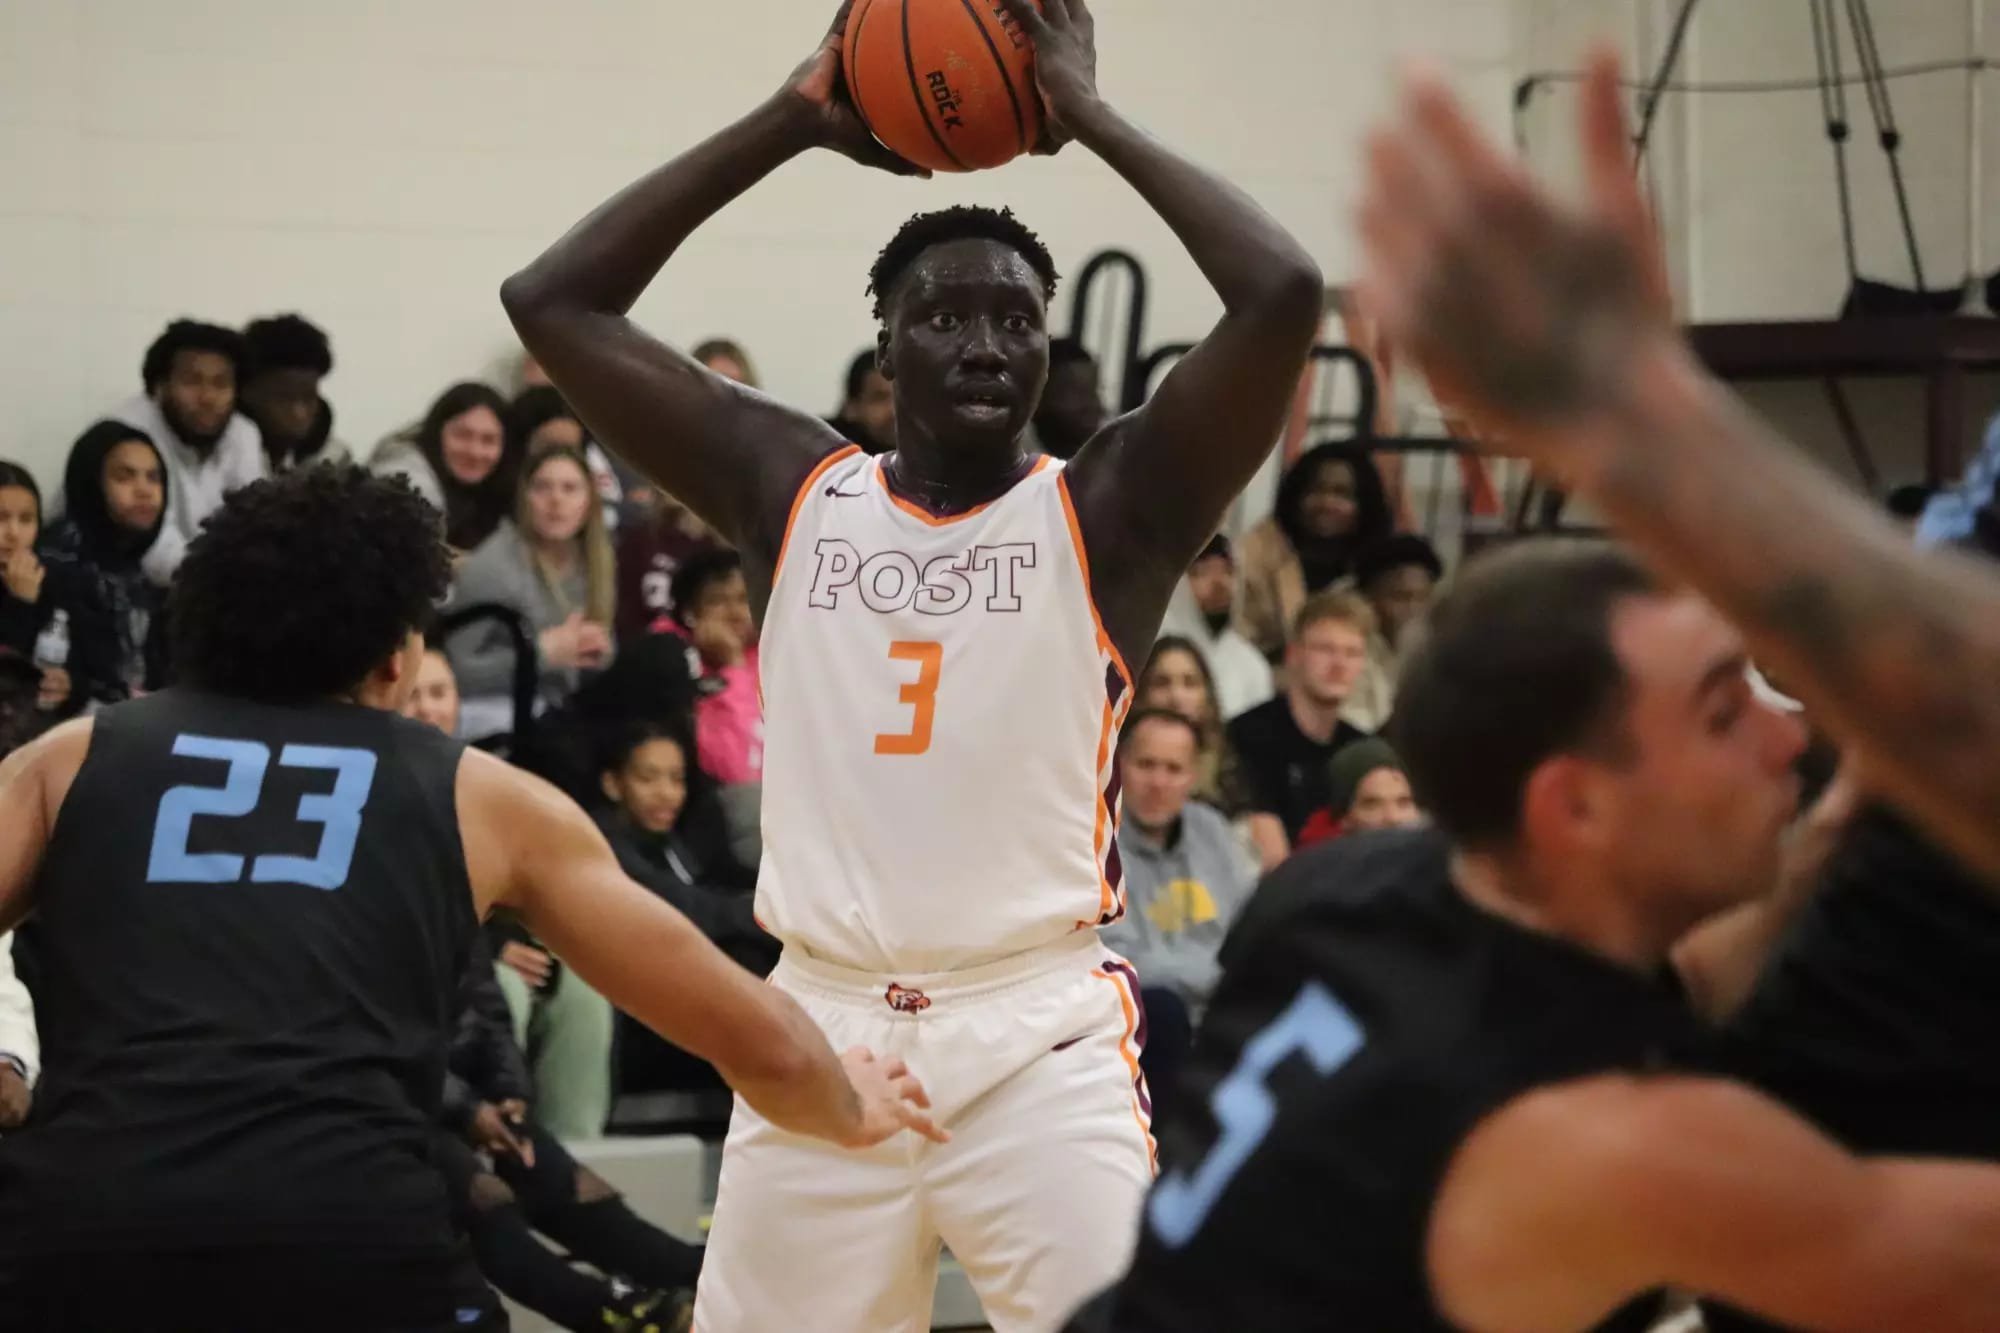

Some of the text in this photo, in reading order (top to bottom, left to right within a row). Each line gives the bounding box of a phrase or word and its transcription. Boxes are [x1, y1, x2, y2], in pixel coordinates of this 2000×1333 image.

[926, 70, 964, 131] ROCK
[808, 537, 1037, 616] POST
[873, 640, 944, 756] 3
[146, 733, 378, 891] 23
